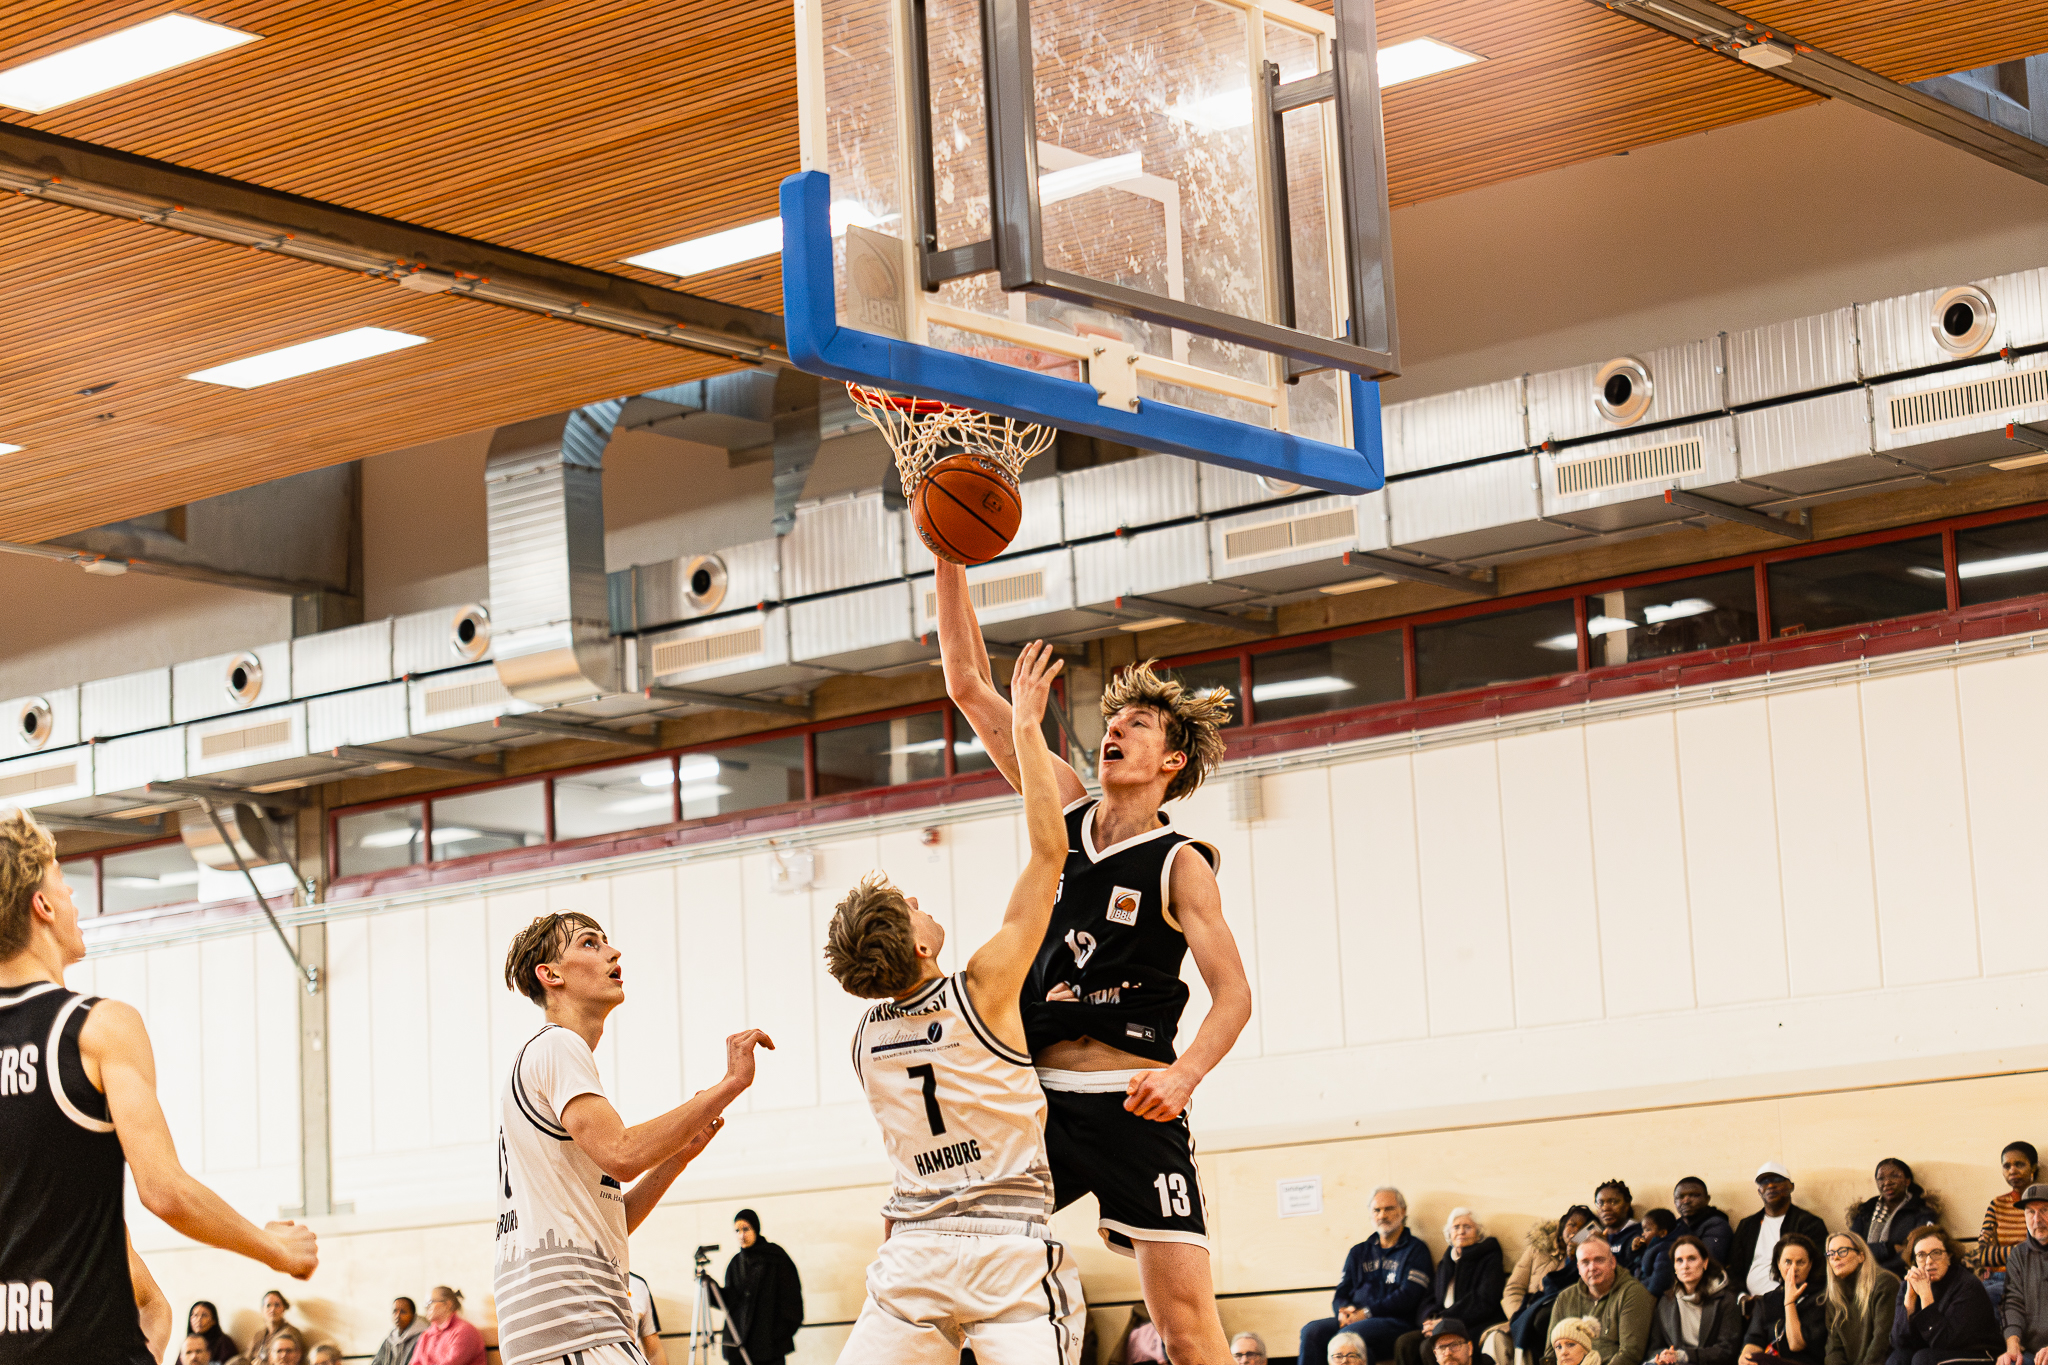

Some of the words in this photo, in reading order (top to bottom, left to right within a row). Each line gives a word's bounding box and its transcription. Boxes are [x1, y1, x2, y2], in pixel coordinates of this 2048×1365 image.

[1109, 909, 1132, 922] JBBL
[0, 1044, 39, 1096] RS
[906, 1063, 947, 1137] 7
[914, 1139, 982, 1177] HAMBURG
[1153, 1172, 1192, 1218] 13
